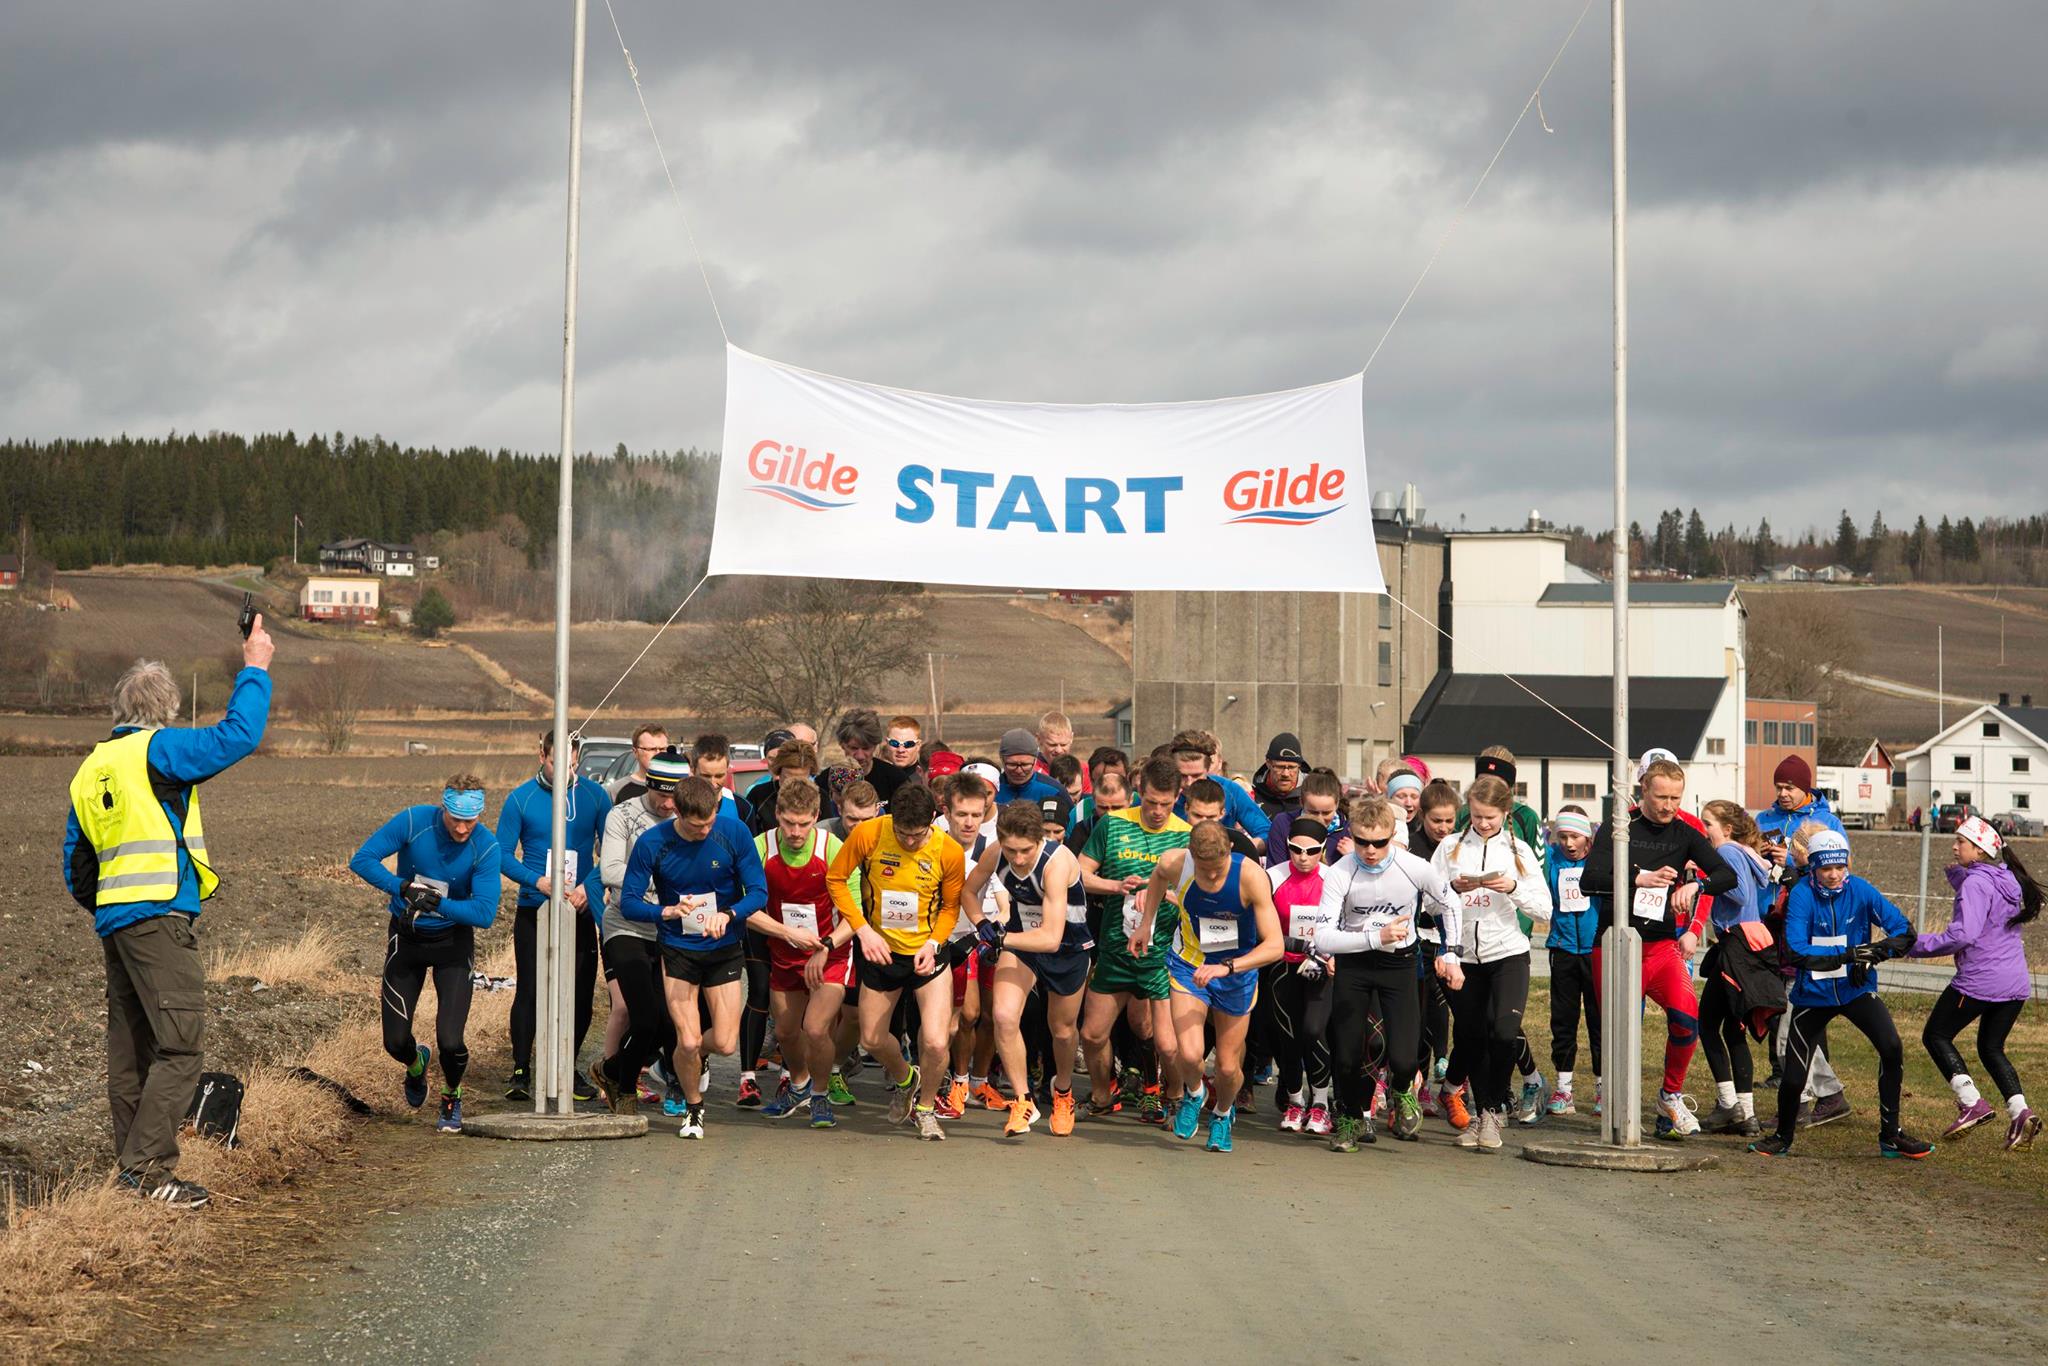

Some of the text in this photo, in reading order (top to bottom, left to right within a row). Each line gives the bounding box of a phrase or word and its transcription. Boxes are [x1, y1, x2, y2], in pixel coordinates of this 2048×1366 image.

[748, 439, 859, 497] Gilde
[1222, 462, 1346, 512] Gilde
[895, 463, 1184, 534] START
[1465, 895, 1491, 908] 243
[1639, 892, 1663, 907] 220
[696, 913, 705, 924] 9
[790, 911, 807, 919] coop
[888, 911, 914, 922] 212
[1298, 926, 1315, 937] 14
